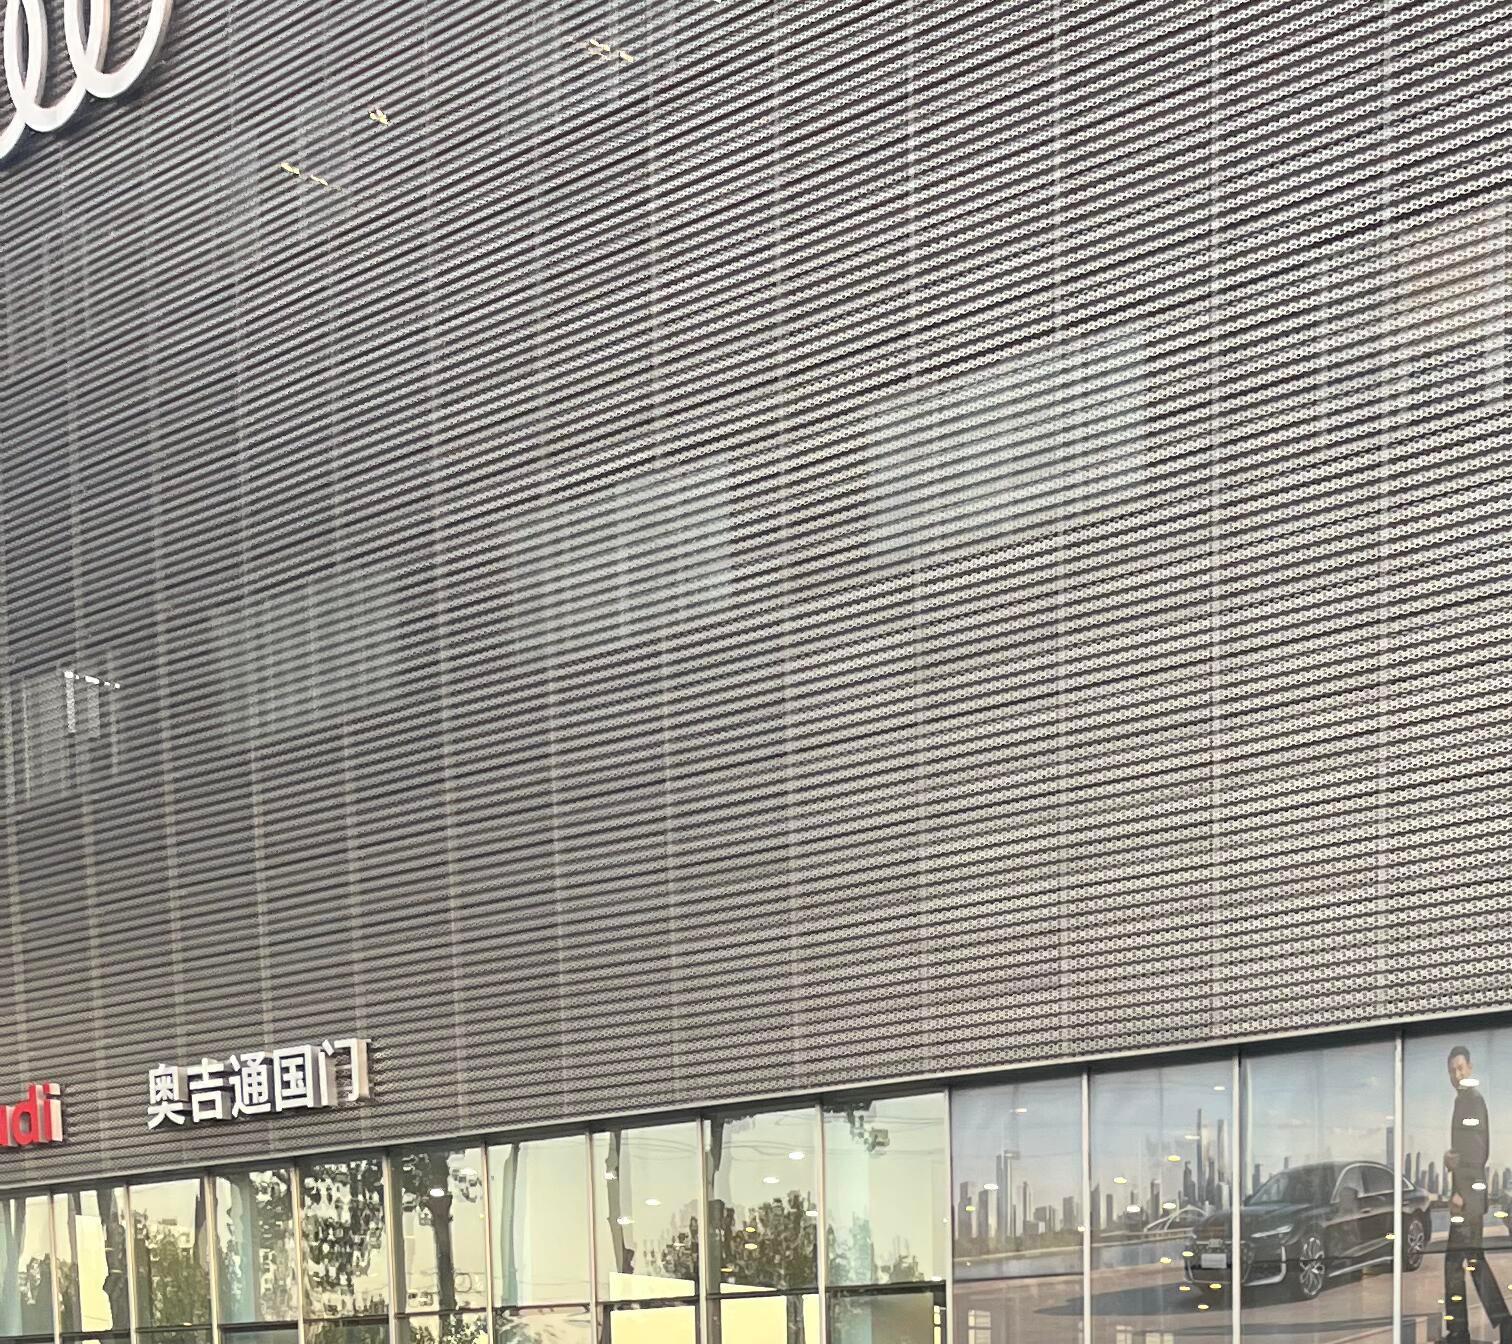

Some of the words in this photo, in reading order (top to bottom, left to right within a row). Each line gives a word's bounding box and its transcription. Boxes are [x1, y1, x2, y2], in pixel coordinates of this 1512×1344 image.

[147, 1038, 371, 1129] 奥吉通国门
